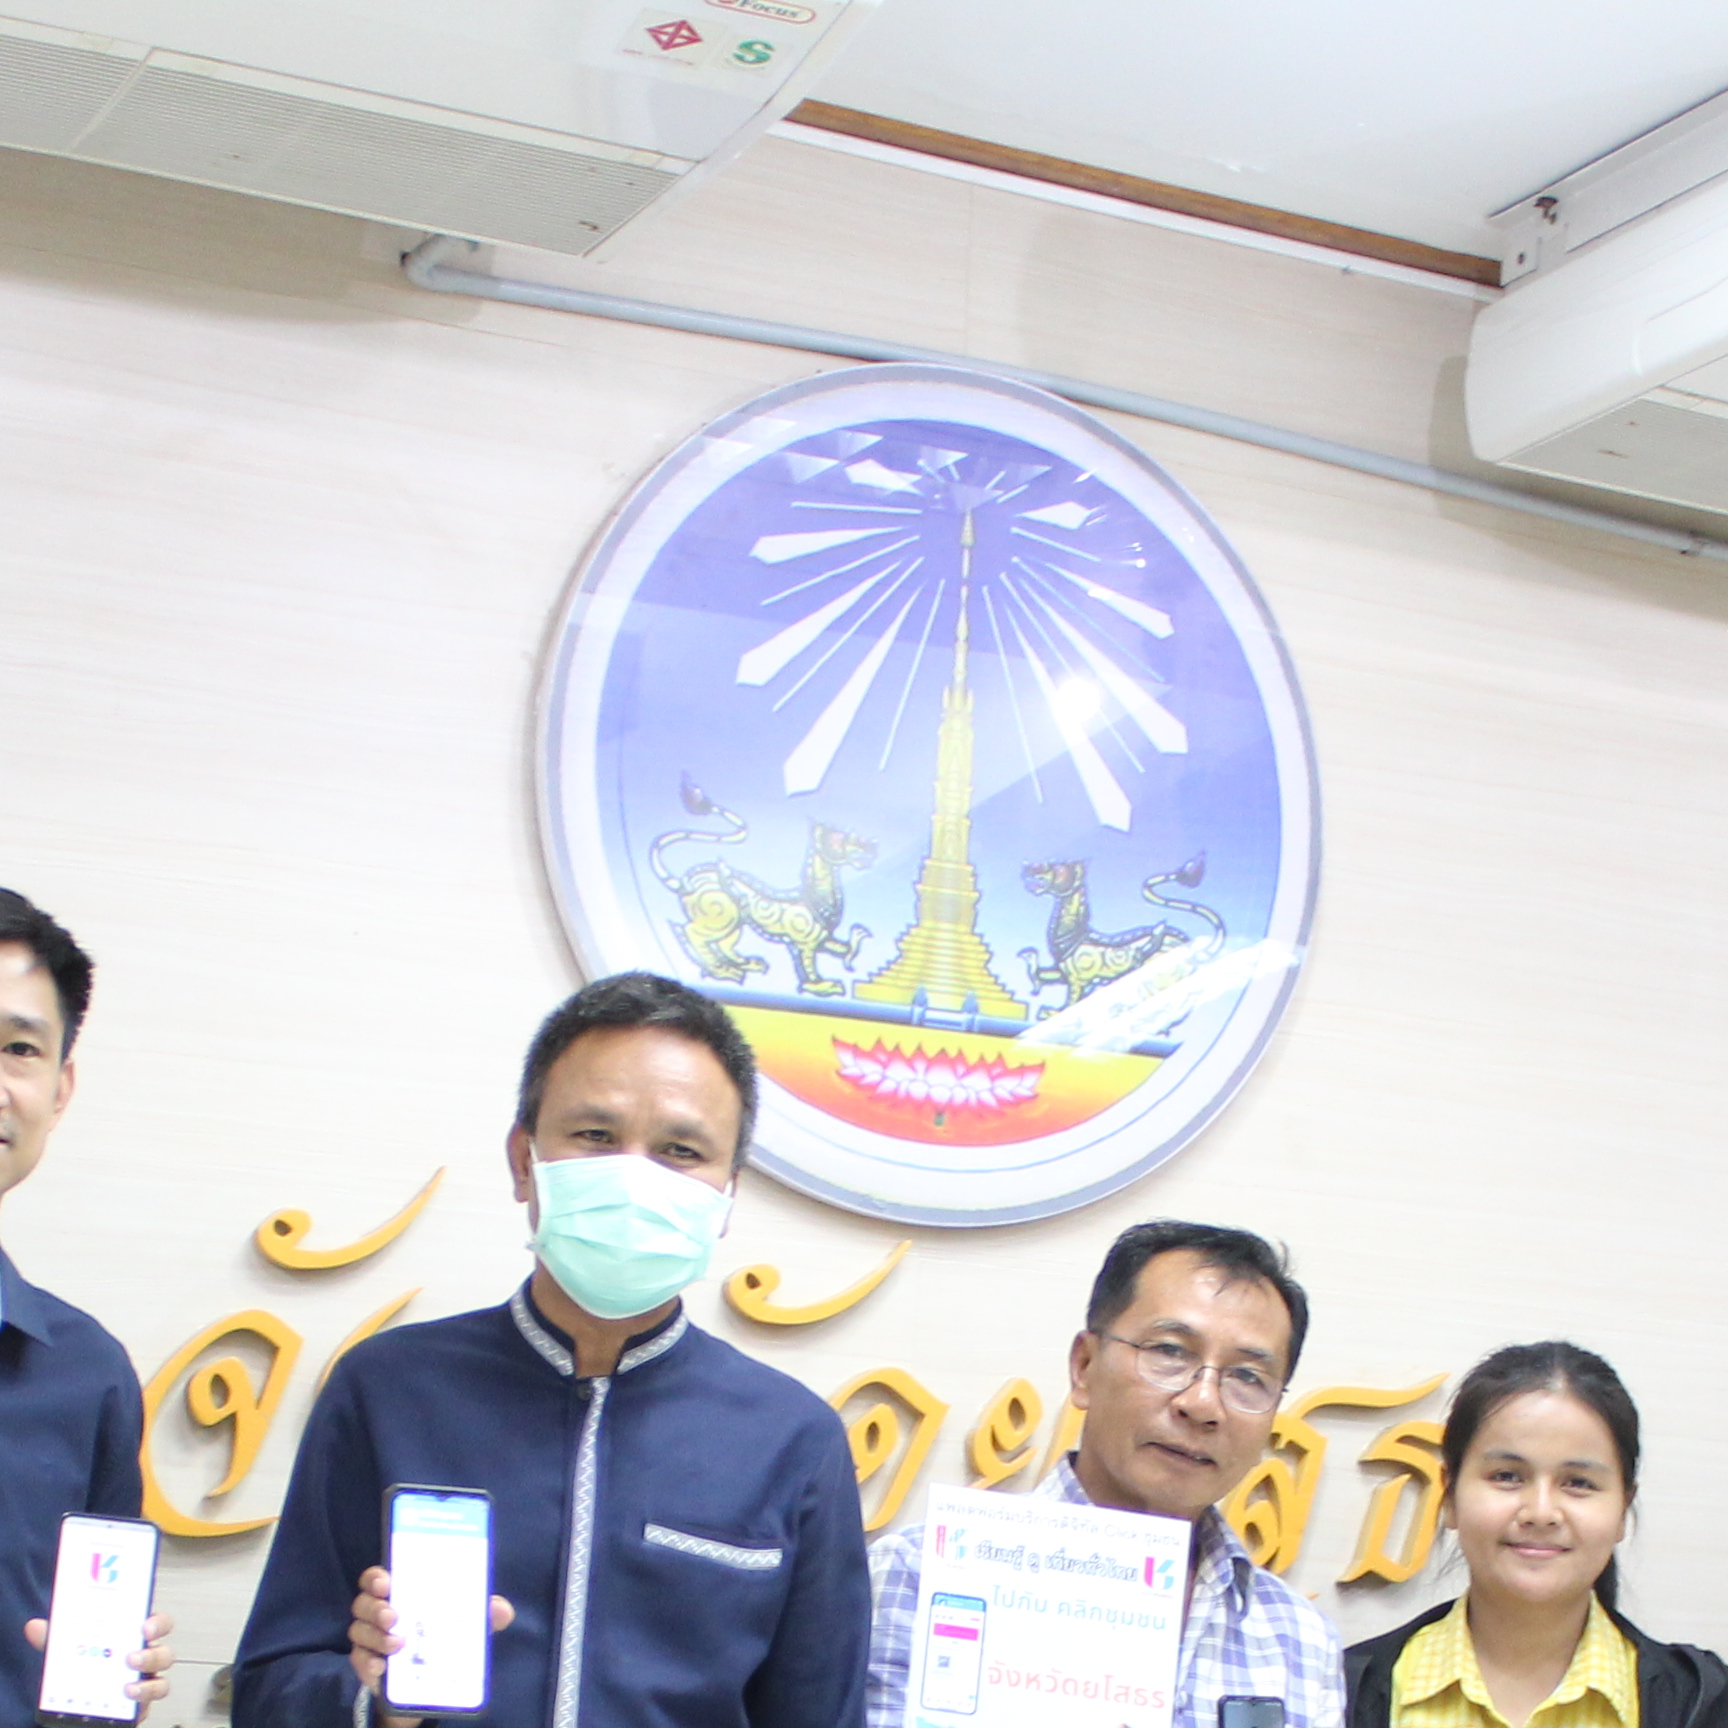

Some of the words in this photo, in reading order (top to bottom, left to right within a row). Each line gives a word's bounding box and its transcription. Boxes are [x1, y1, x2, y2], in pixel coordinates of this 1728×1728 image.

[992, 1583, 1048, 1614] ไปกับ
[1056, 1598, 1166, 1631] คลิกชุมชน
[986, 1659, 1166, 1710] จังหวัดยโสธร
